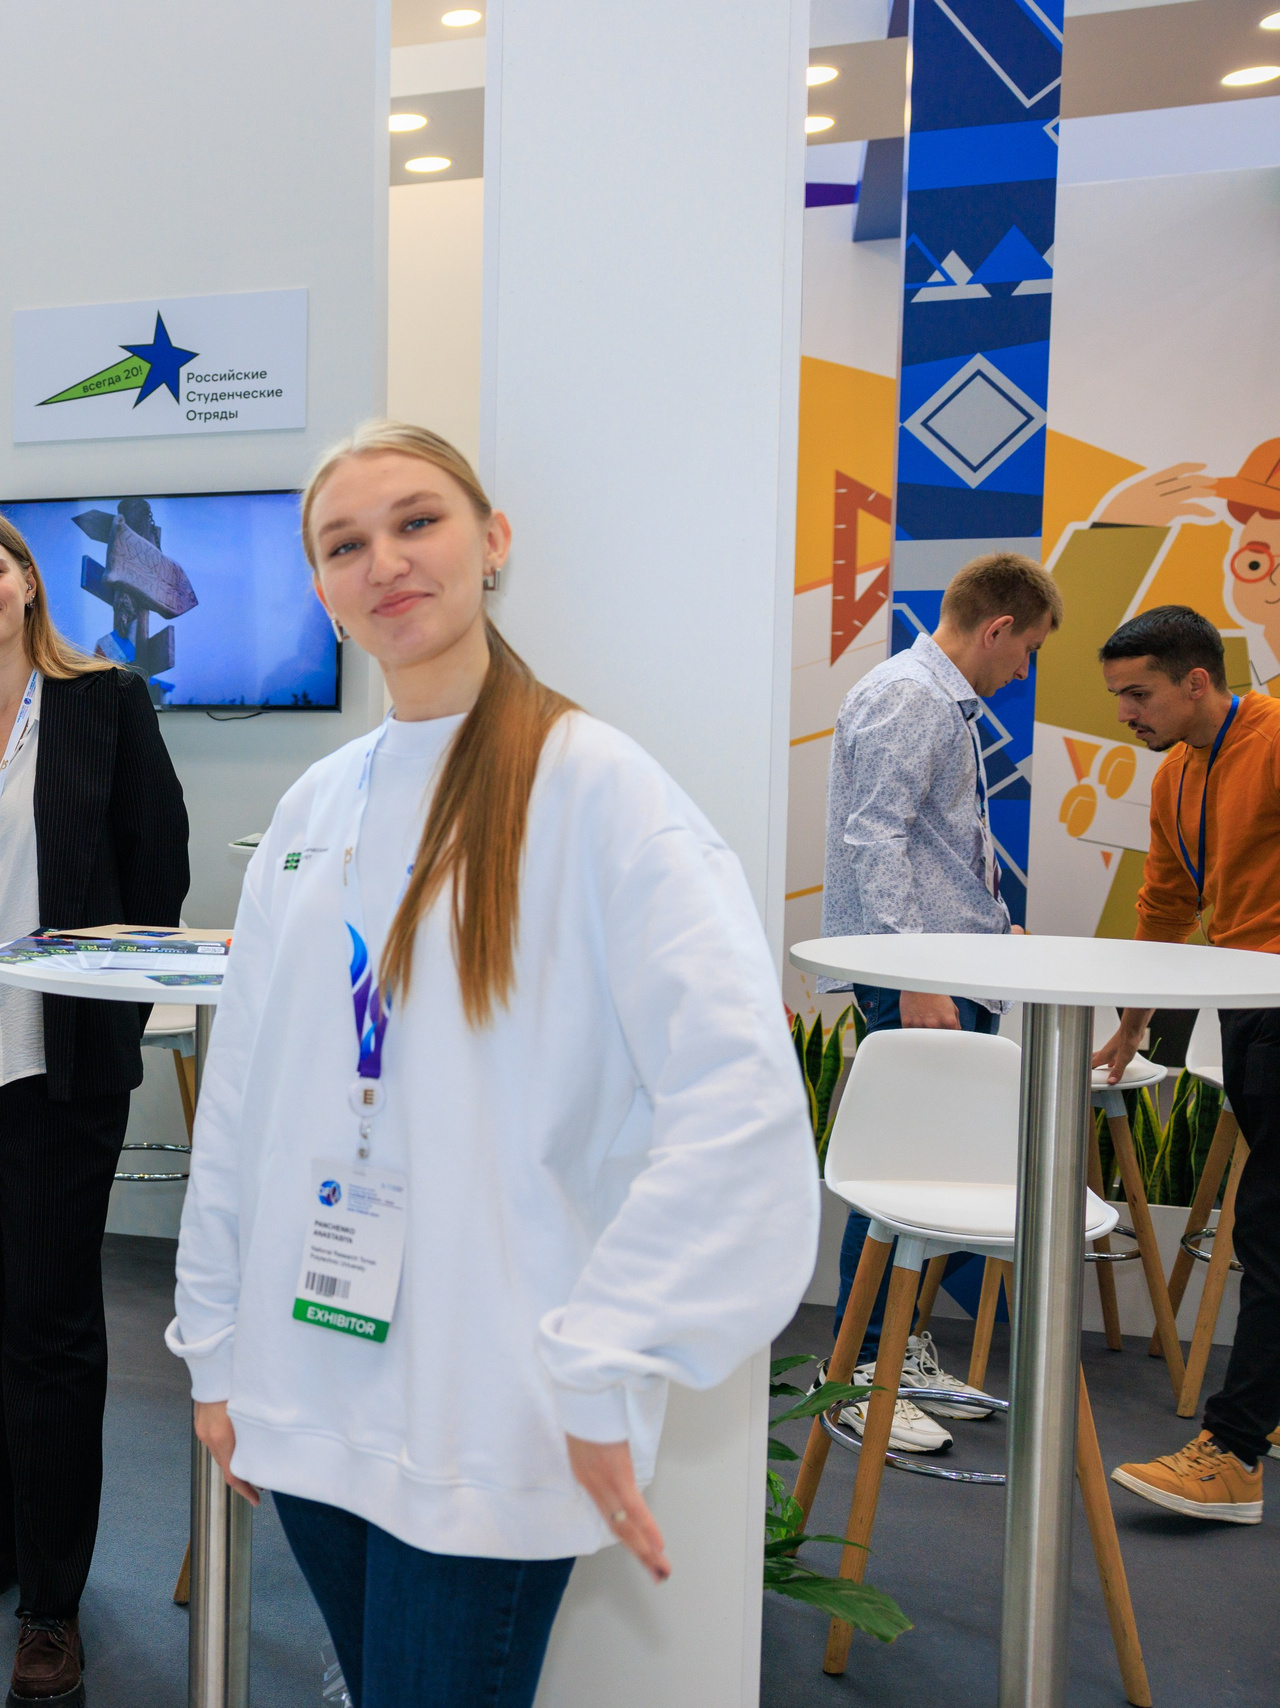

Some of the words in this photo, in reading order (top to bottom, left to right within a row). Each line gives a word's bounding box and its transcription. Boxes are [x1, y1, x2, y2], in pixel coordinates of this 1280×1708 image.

[82, 375, 122, 393] всегда
[123, 365, 144, 380] 20!
[186, 369, 268, 383] Российские
[186, 388, 283, 403] Студенческие
[186, 409, 238, 422] Отряды
[306, 1306, 376, 1335] EXHIBITOR
